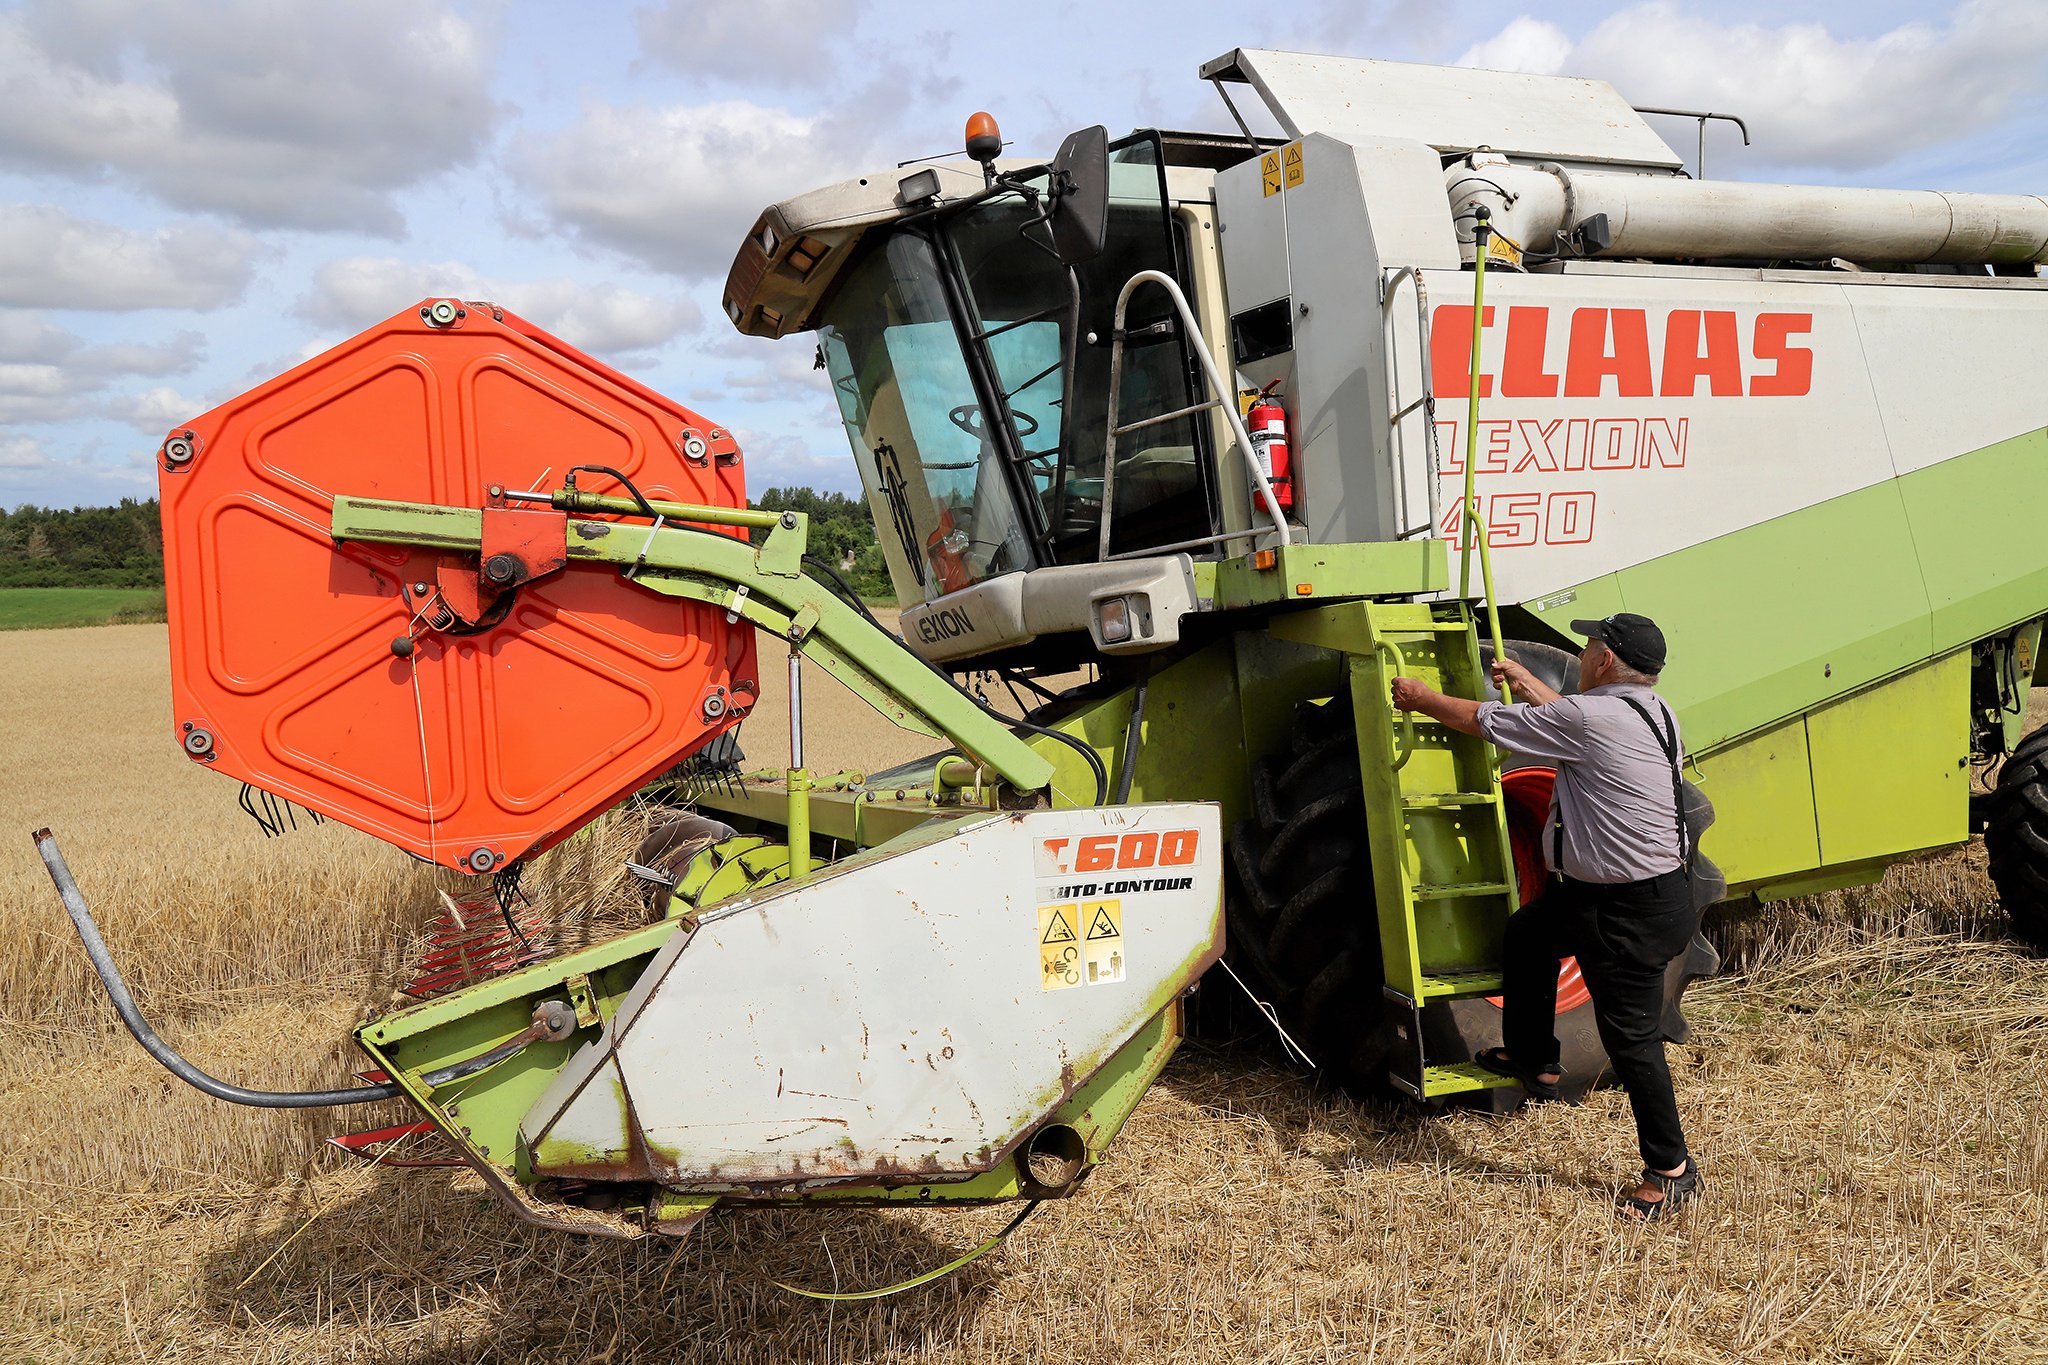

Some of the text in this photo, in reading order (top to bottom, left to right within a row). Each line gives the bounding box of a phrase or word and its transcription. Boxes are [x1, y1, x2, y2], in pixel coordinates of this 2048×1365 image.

[1431, 304, 1814, 398] CLAAS
[1434, 417, 1689, 475] LEXION
[1440, 490, 1597, 551] 450
[911, 605, 976, 645] LEXION
[1048, 877, 1193, 899] UTO-CONTOUR
